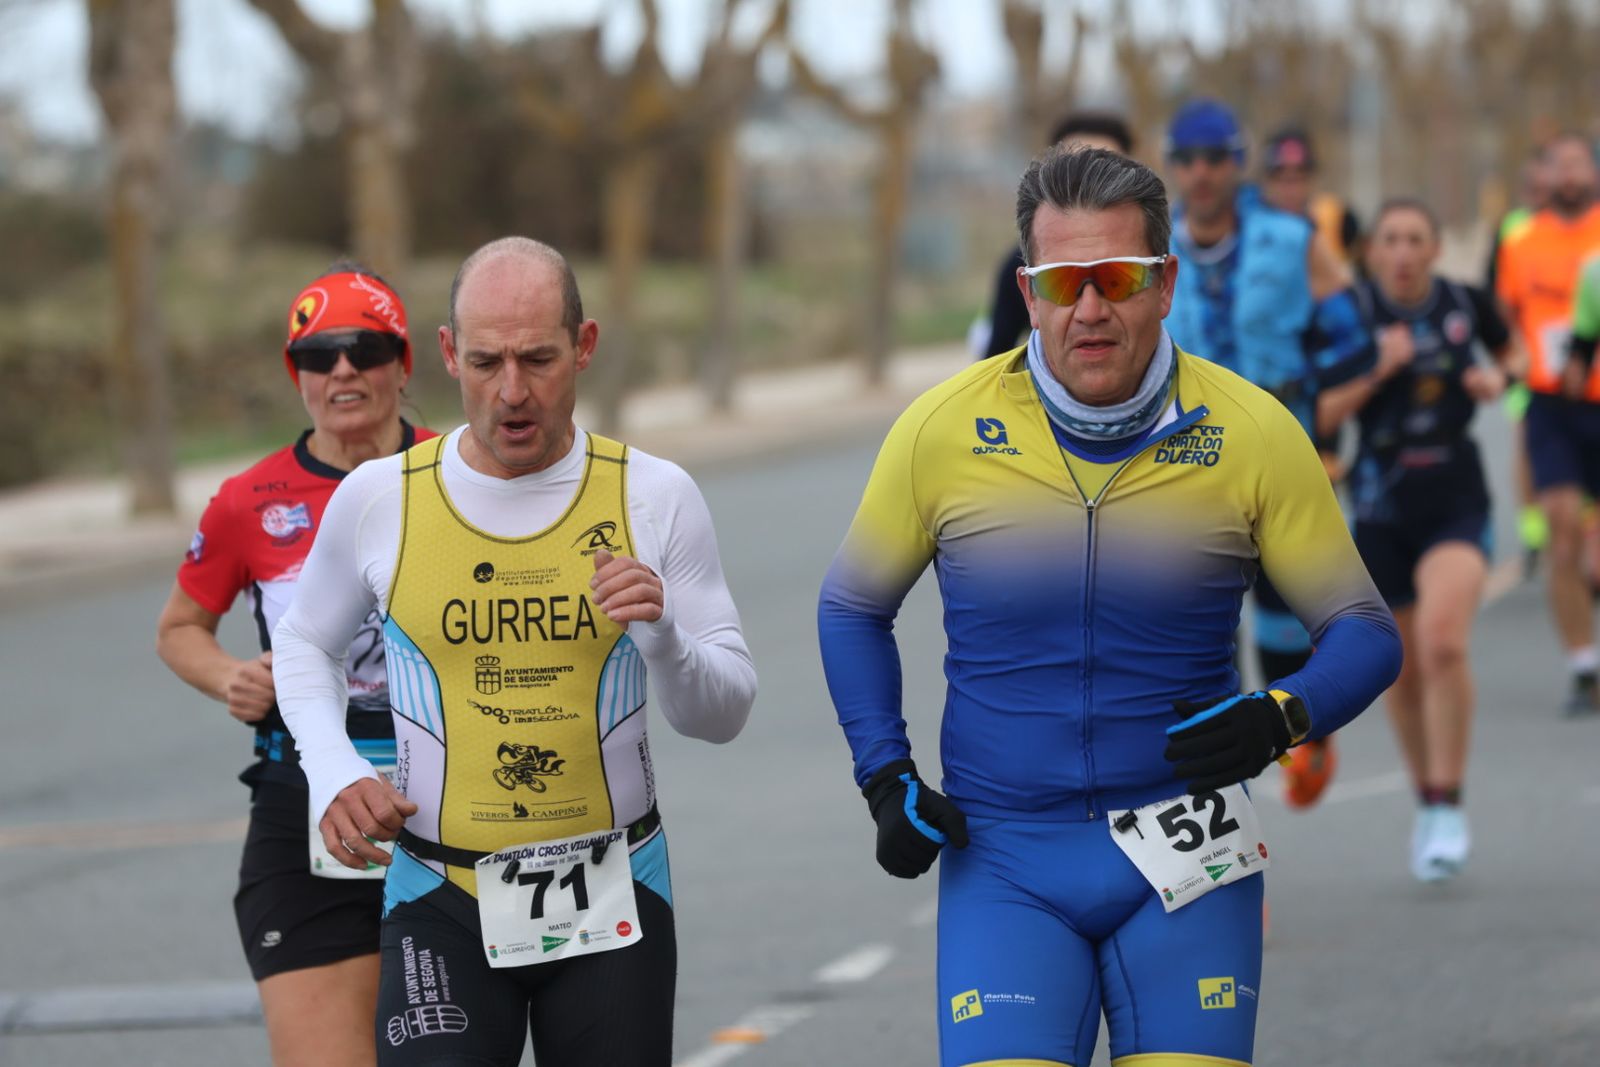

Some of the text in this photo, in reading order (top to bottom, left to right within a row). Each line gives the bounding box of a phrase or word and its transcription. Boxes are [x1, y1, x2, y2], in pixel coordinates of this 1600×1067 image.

[1154, 448, 1220, 467] DUERO
[442, 593, 598, 645] GURREA
[504, 665, 574, 676] AYUNTAMIENTO
[518, 674, 558, 683] SEGOVIA
[471, 810, 510, 819] VIVEROS
[532, 804, 588, 818] CAMPIÑAS
[1156, 789, 1240, 853] 52
[538, 843, 568, 857] CROSS
[517, 862, 589, 920] 71
[548, 922, 572, 932] MATEO
[402, 936, 422, 1004] AYUNTAMIENTO
[418, 949, 439, 1002] DE SEGOVIA
